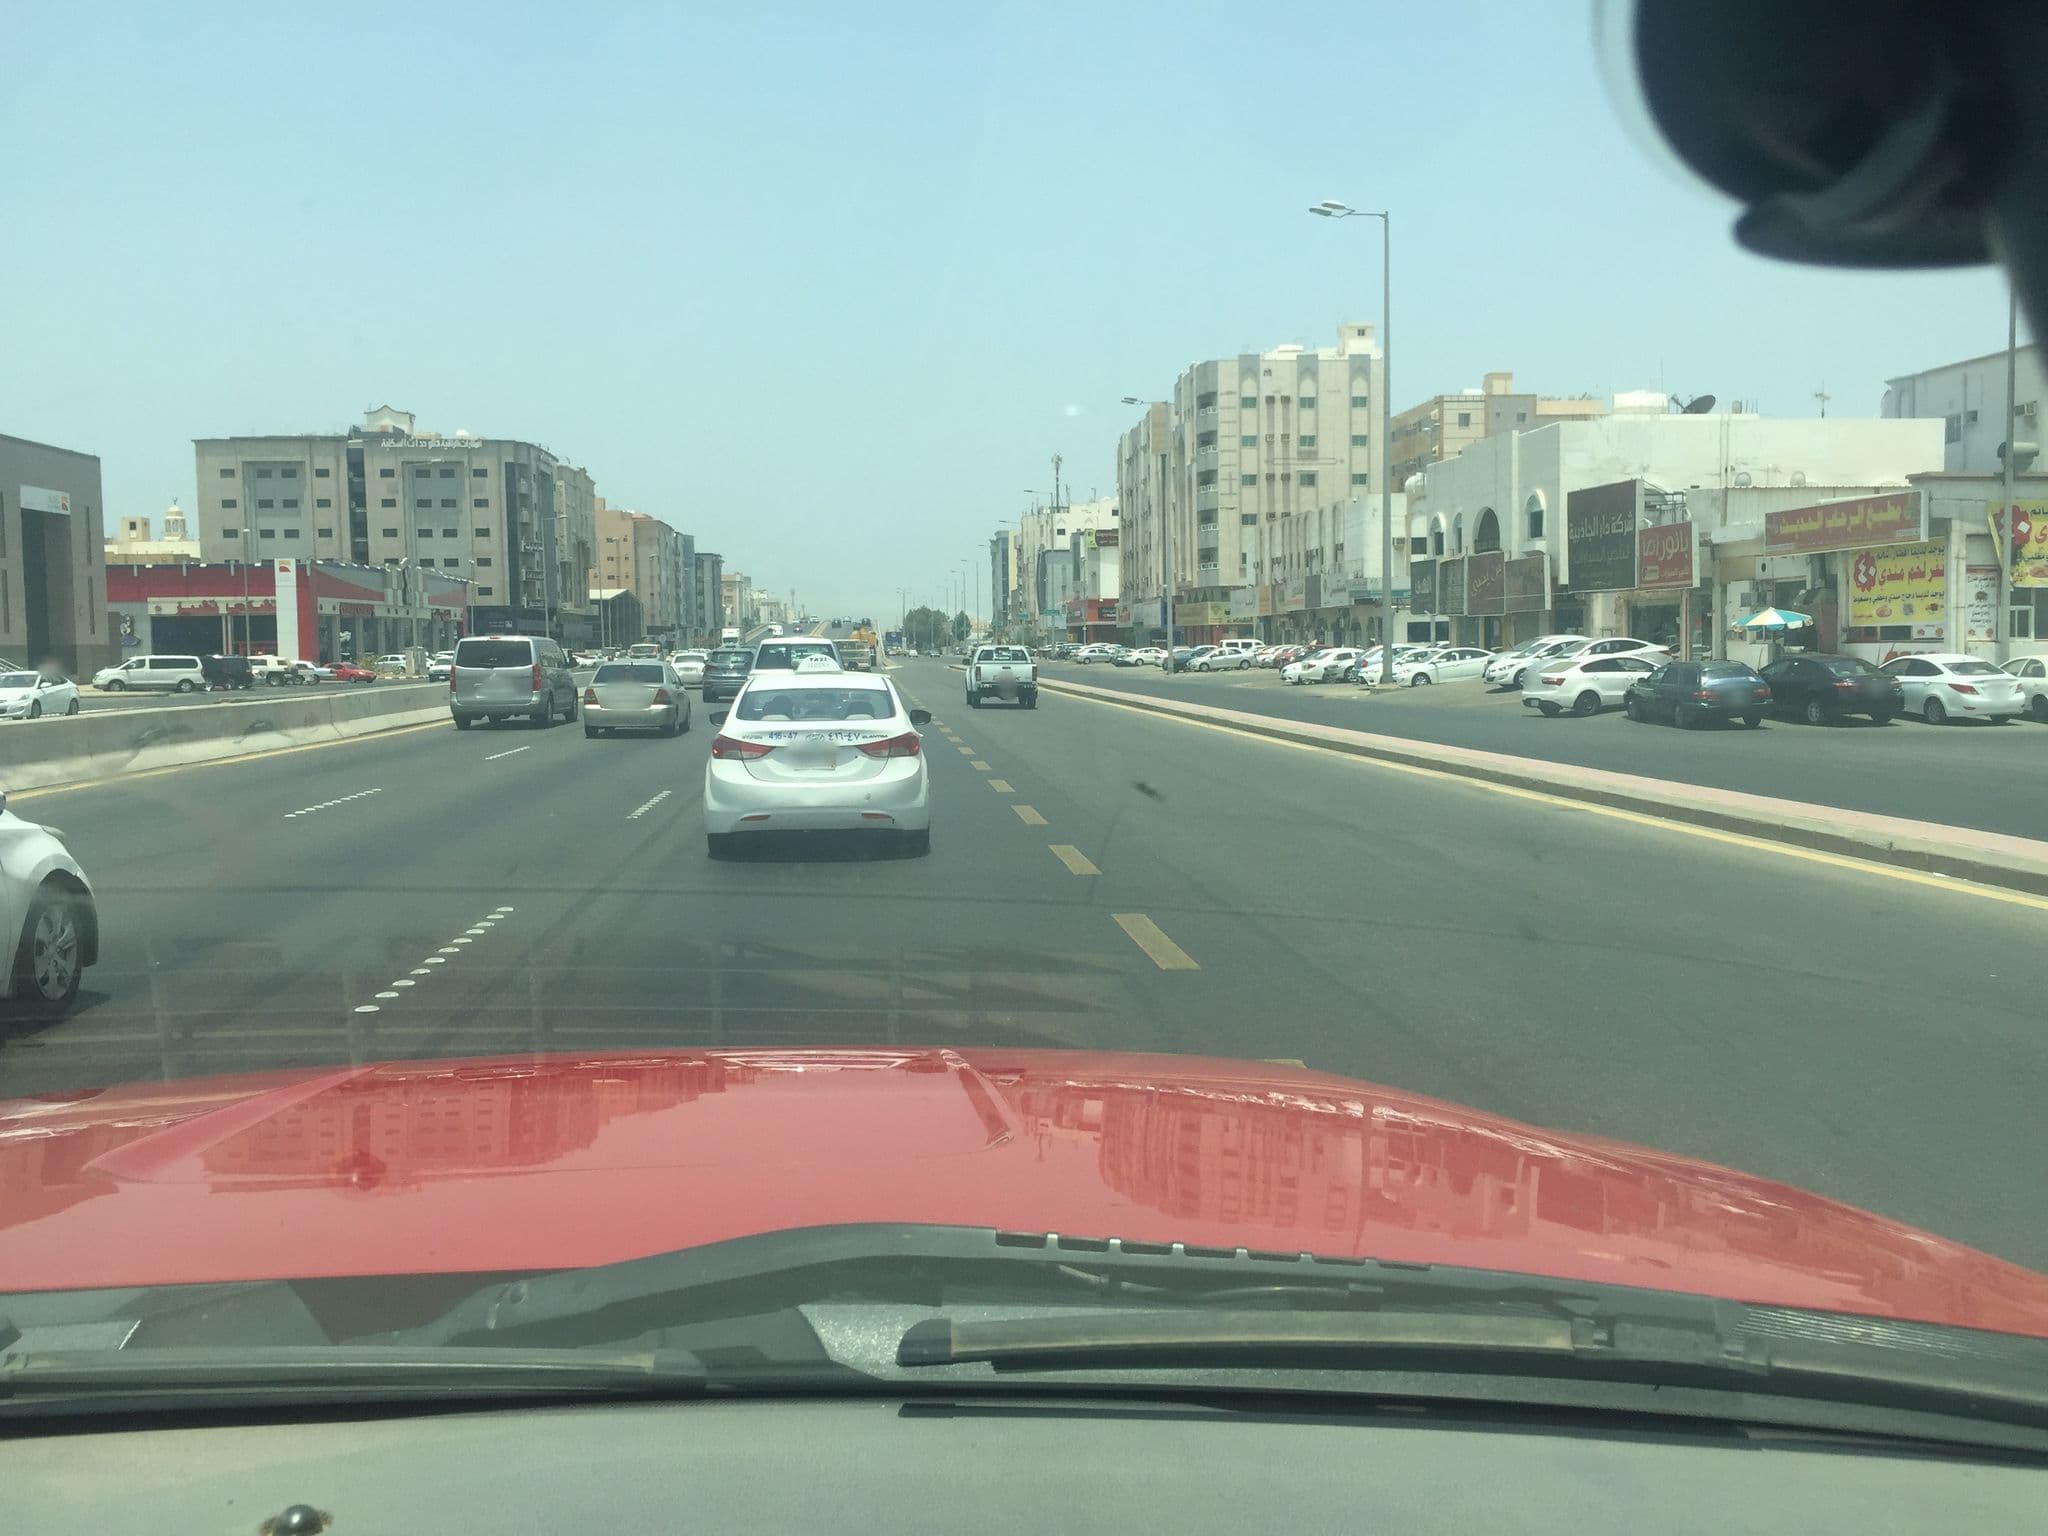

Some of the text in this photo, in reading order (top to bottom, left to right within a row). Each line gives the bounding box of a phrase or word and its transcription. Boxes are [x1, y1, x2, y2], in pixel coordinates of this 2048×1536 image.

[1611, 511, 1635, 536] شركة
[1879, 566, 1905, 591] مندي
[1907, 560, 1927, 585] لحم
